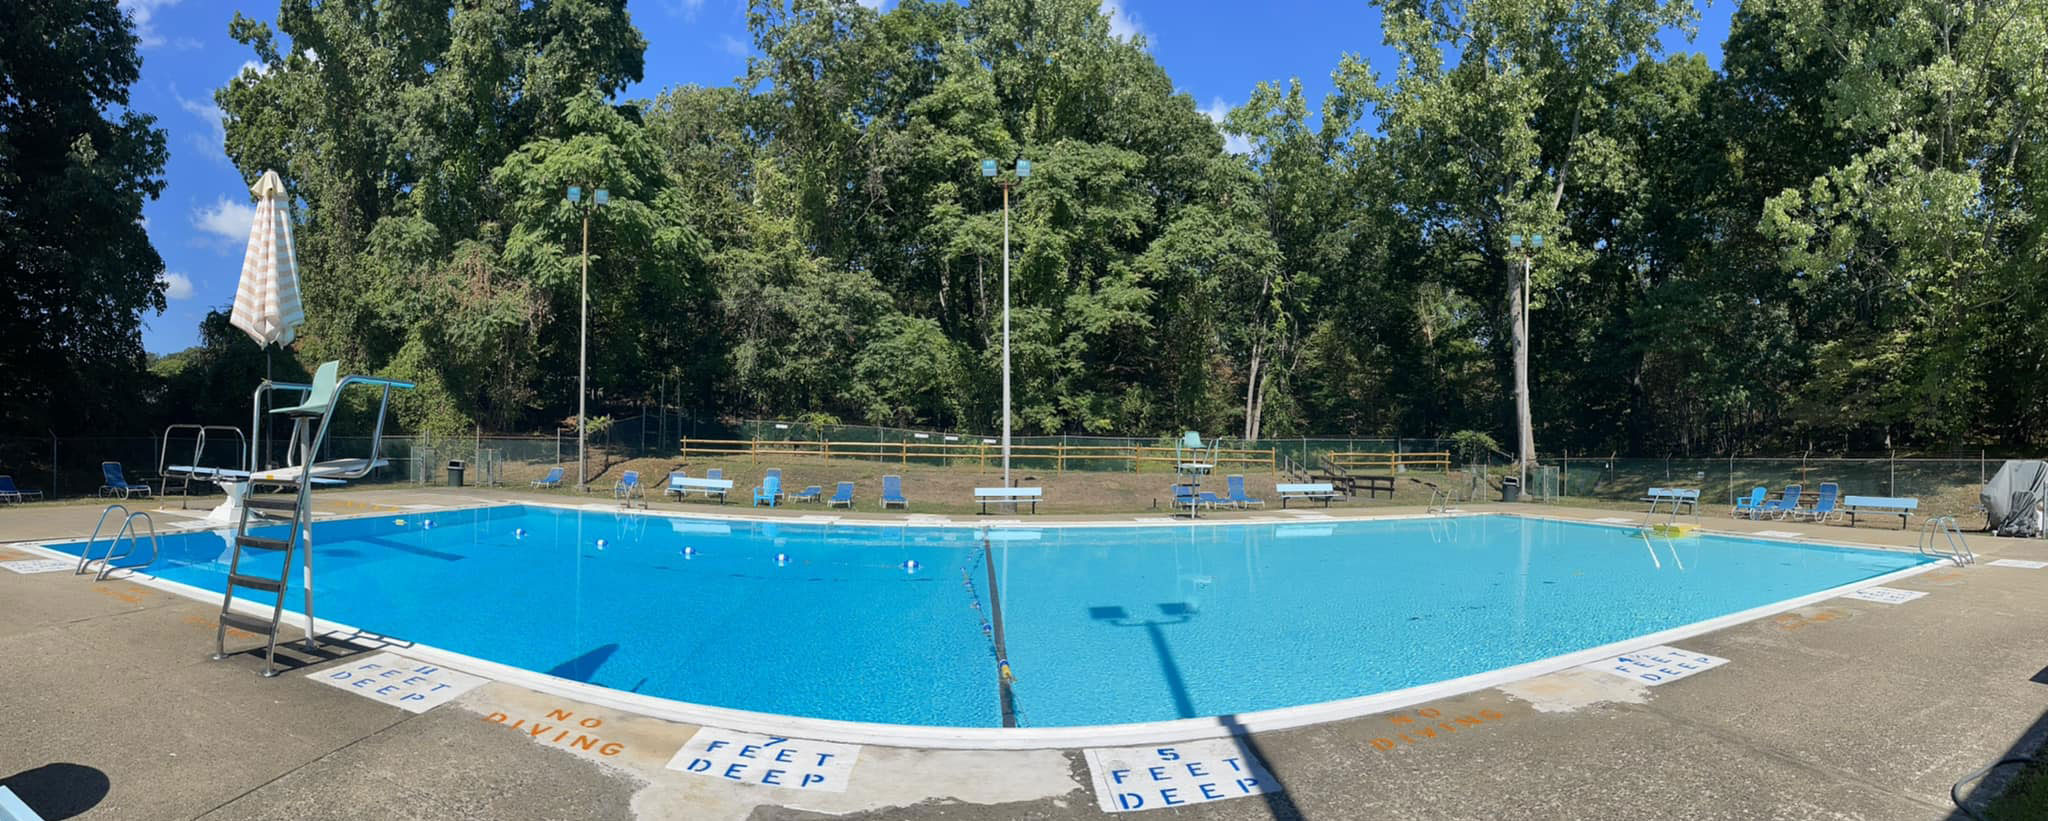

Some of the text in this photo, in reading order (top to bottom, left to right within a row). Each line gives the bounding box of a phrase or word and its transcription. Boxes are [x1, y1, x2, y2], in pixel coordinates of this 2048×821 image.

[1615, 651, 1686, 673] FEET
[1640, 656, 1710, 682] DEEP
[330, 671, 425, 701] DEEP
[357, 663, 451, 692] FEET
[545, 708, 603, 729] NO
[482, 712, 625, 756] DIVING
[763, 736, 789, 748] 7
[706, 740, 835, 767] FEET
[1157, 747, 1181, 761] 5
[687, 758, 825, 788] DEEP
[1111, 757, 1241, 785] FEET
[1118, 778, 1259, 810] DEEP
